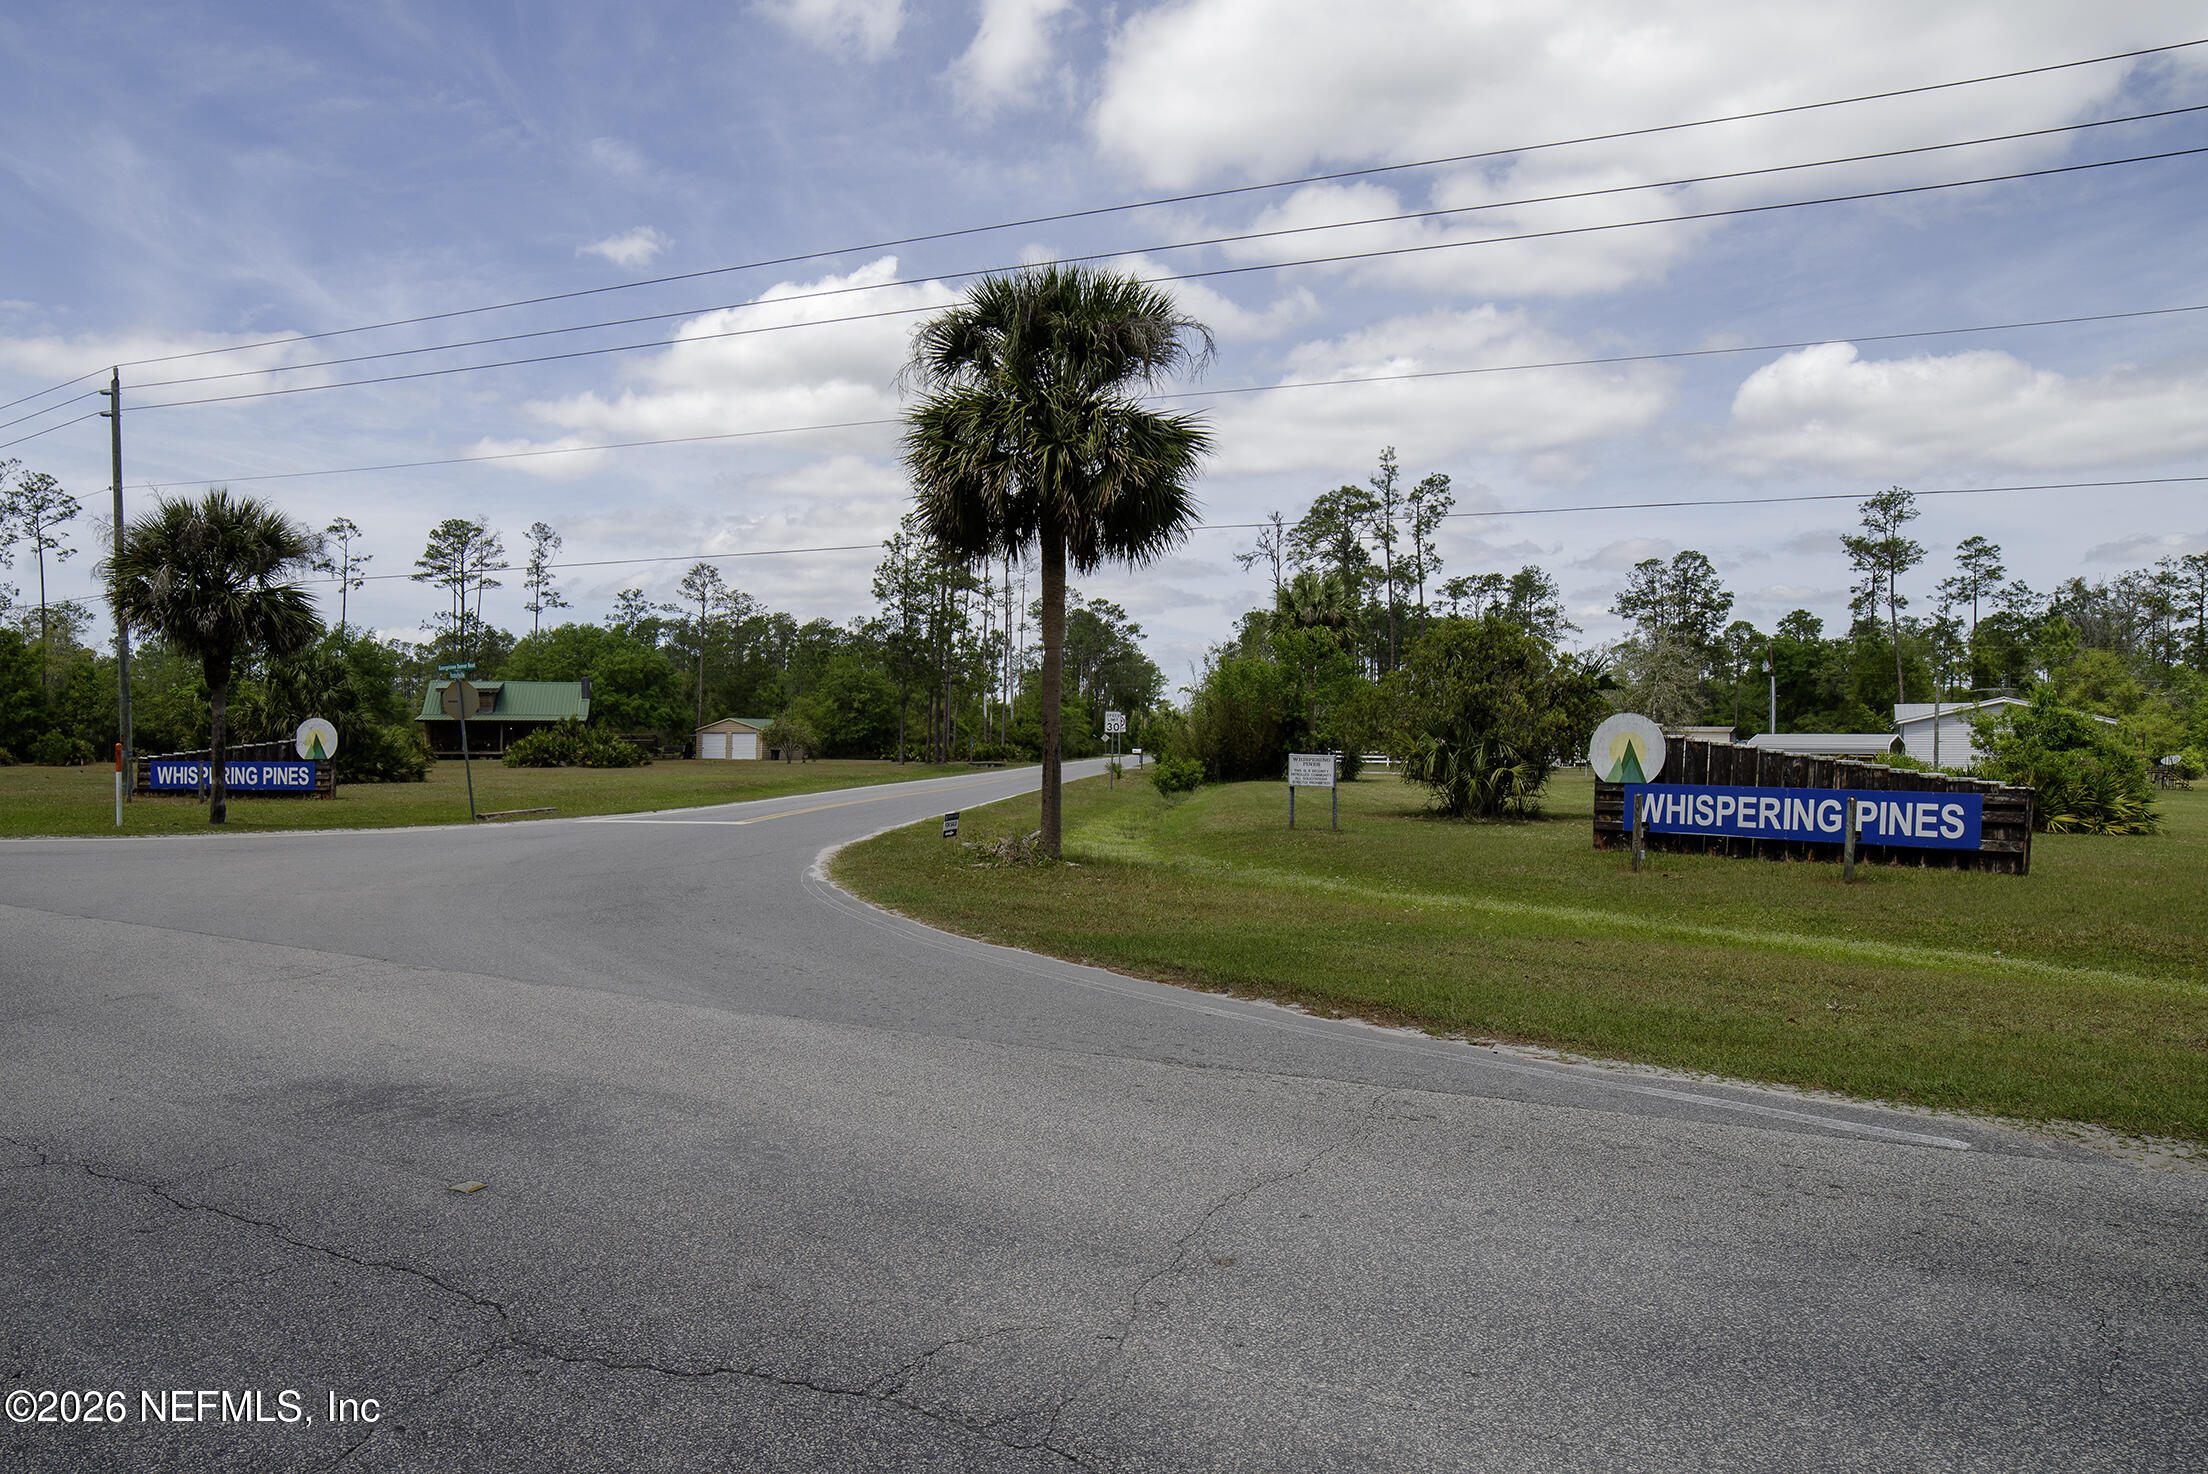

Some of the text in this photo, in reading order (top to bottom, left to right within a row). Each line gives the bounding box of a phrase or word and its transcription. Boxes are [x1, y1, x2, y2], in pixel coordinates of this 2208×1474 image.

[1107, 723, 1119, 731] 30
[263, 767, 310, 785] PINES
[1641, 793, 1966, 839] WHISPERING PINES
